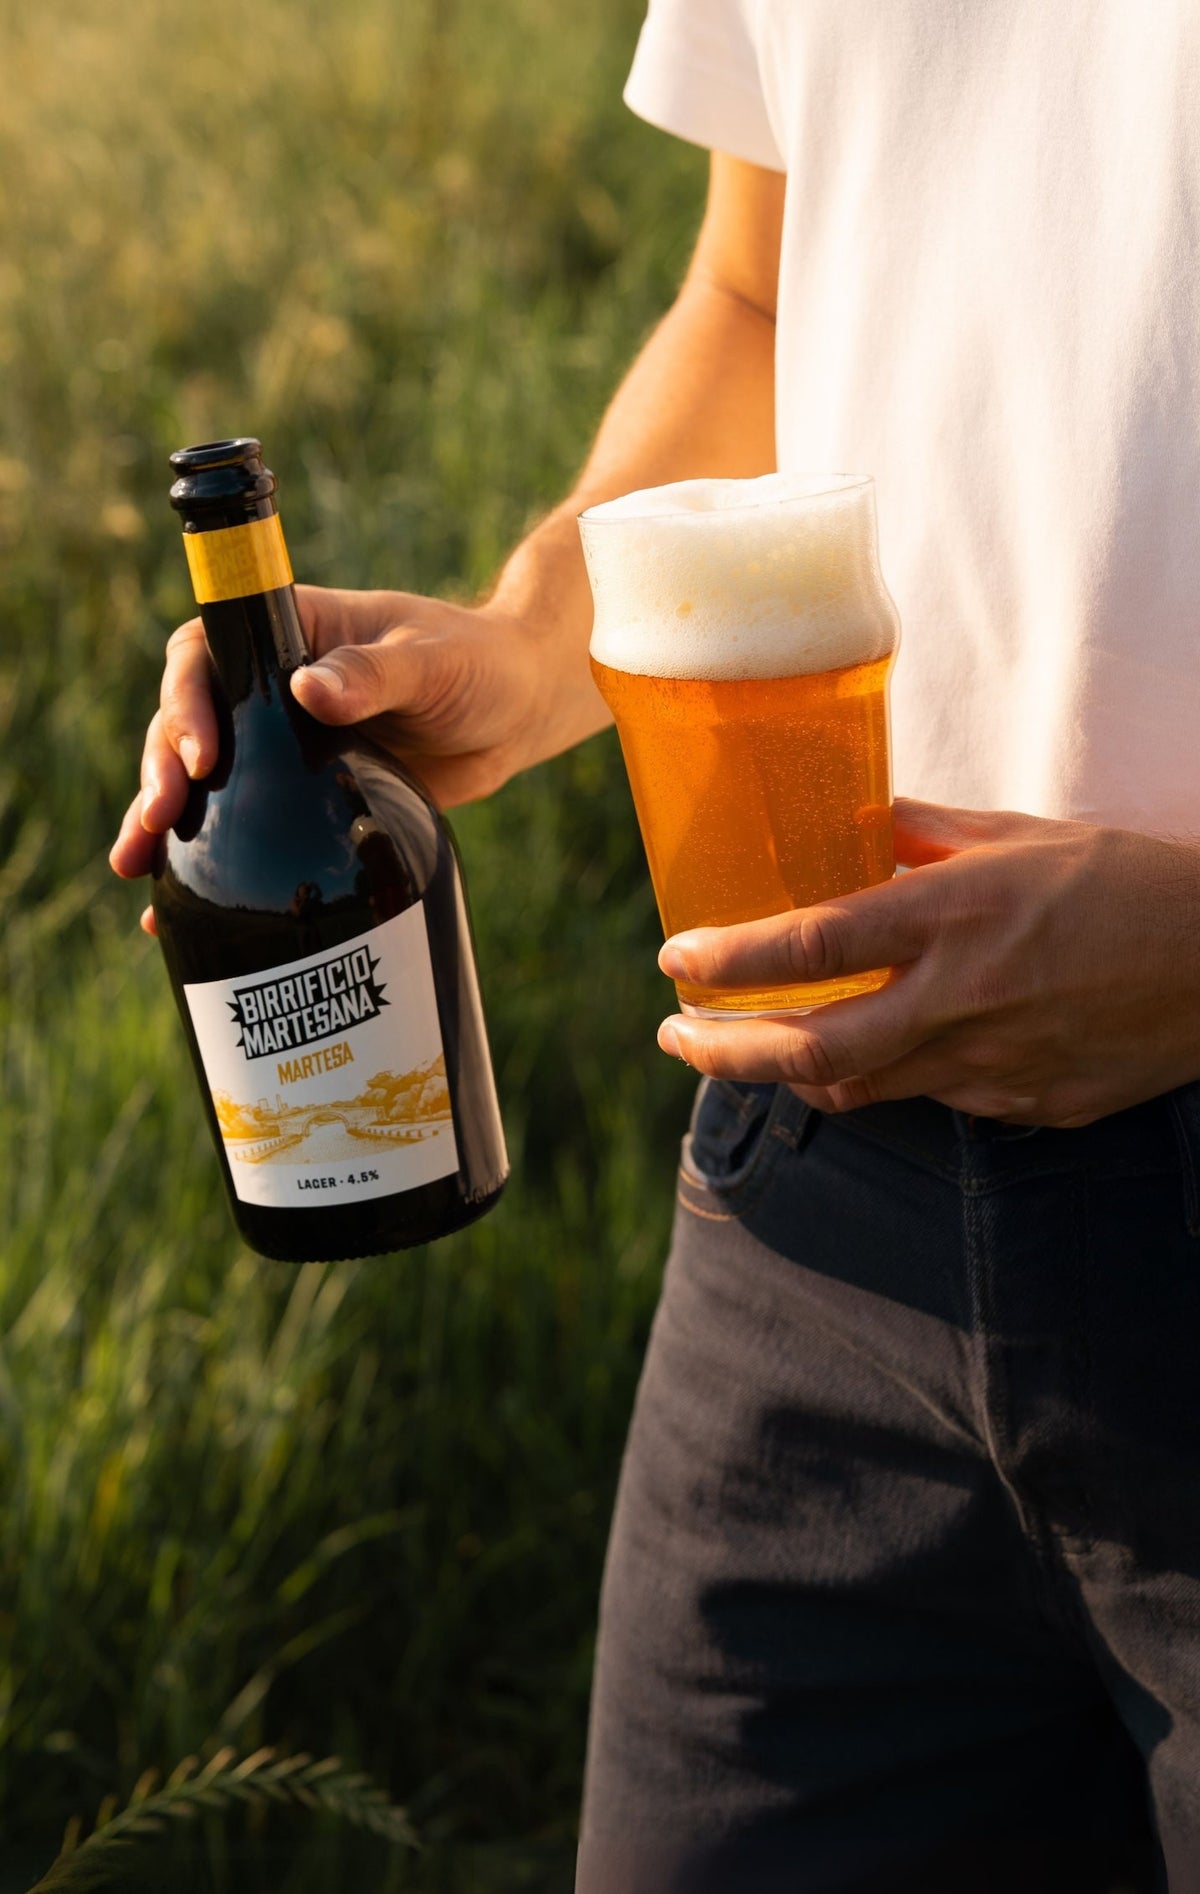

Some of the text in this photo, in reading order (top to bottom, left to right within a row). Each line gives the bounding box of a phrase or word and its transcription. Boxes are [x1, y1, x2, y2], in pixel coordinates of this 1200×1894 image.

[237, 948, 371, 1025] BIRRIFICIO
[242, 983, 376, 1058] MARTESANA
[277, 1041, 354, 1086] MARTESA
[297, 1177, 337, 1190] LAGER
[347, 1169, 379, 1184] 4.5%
